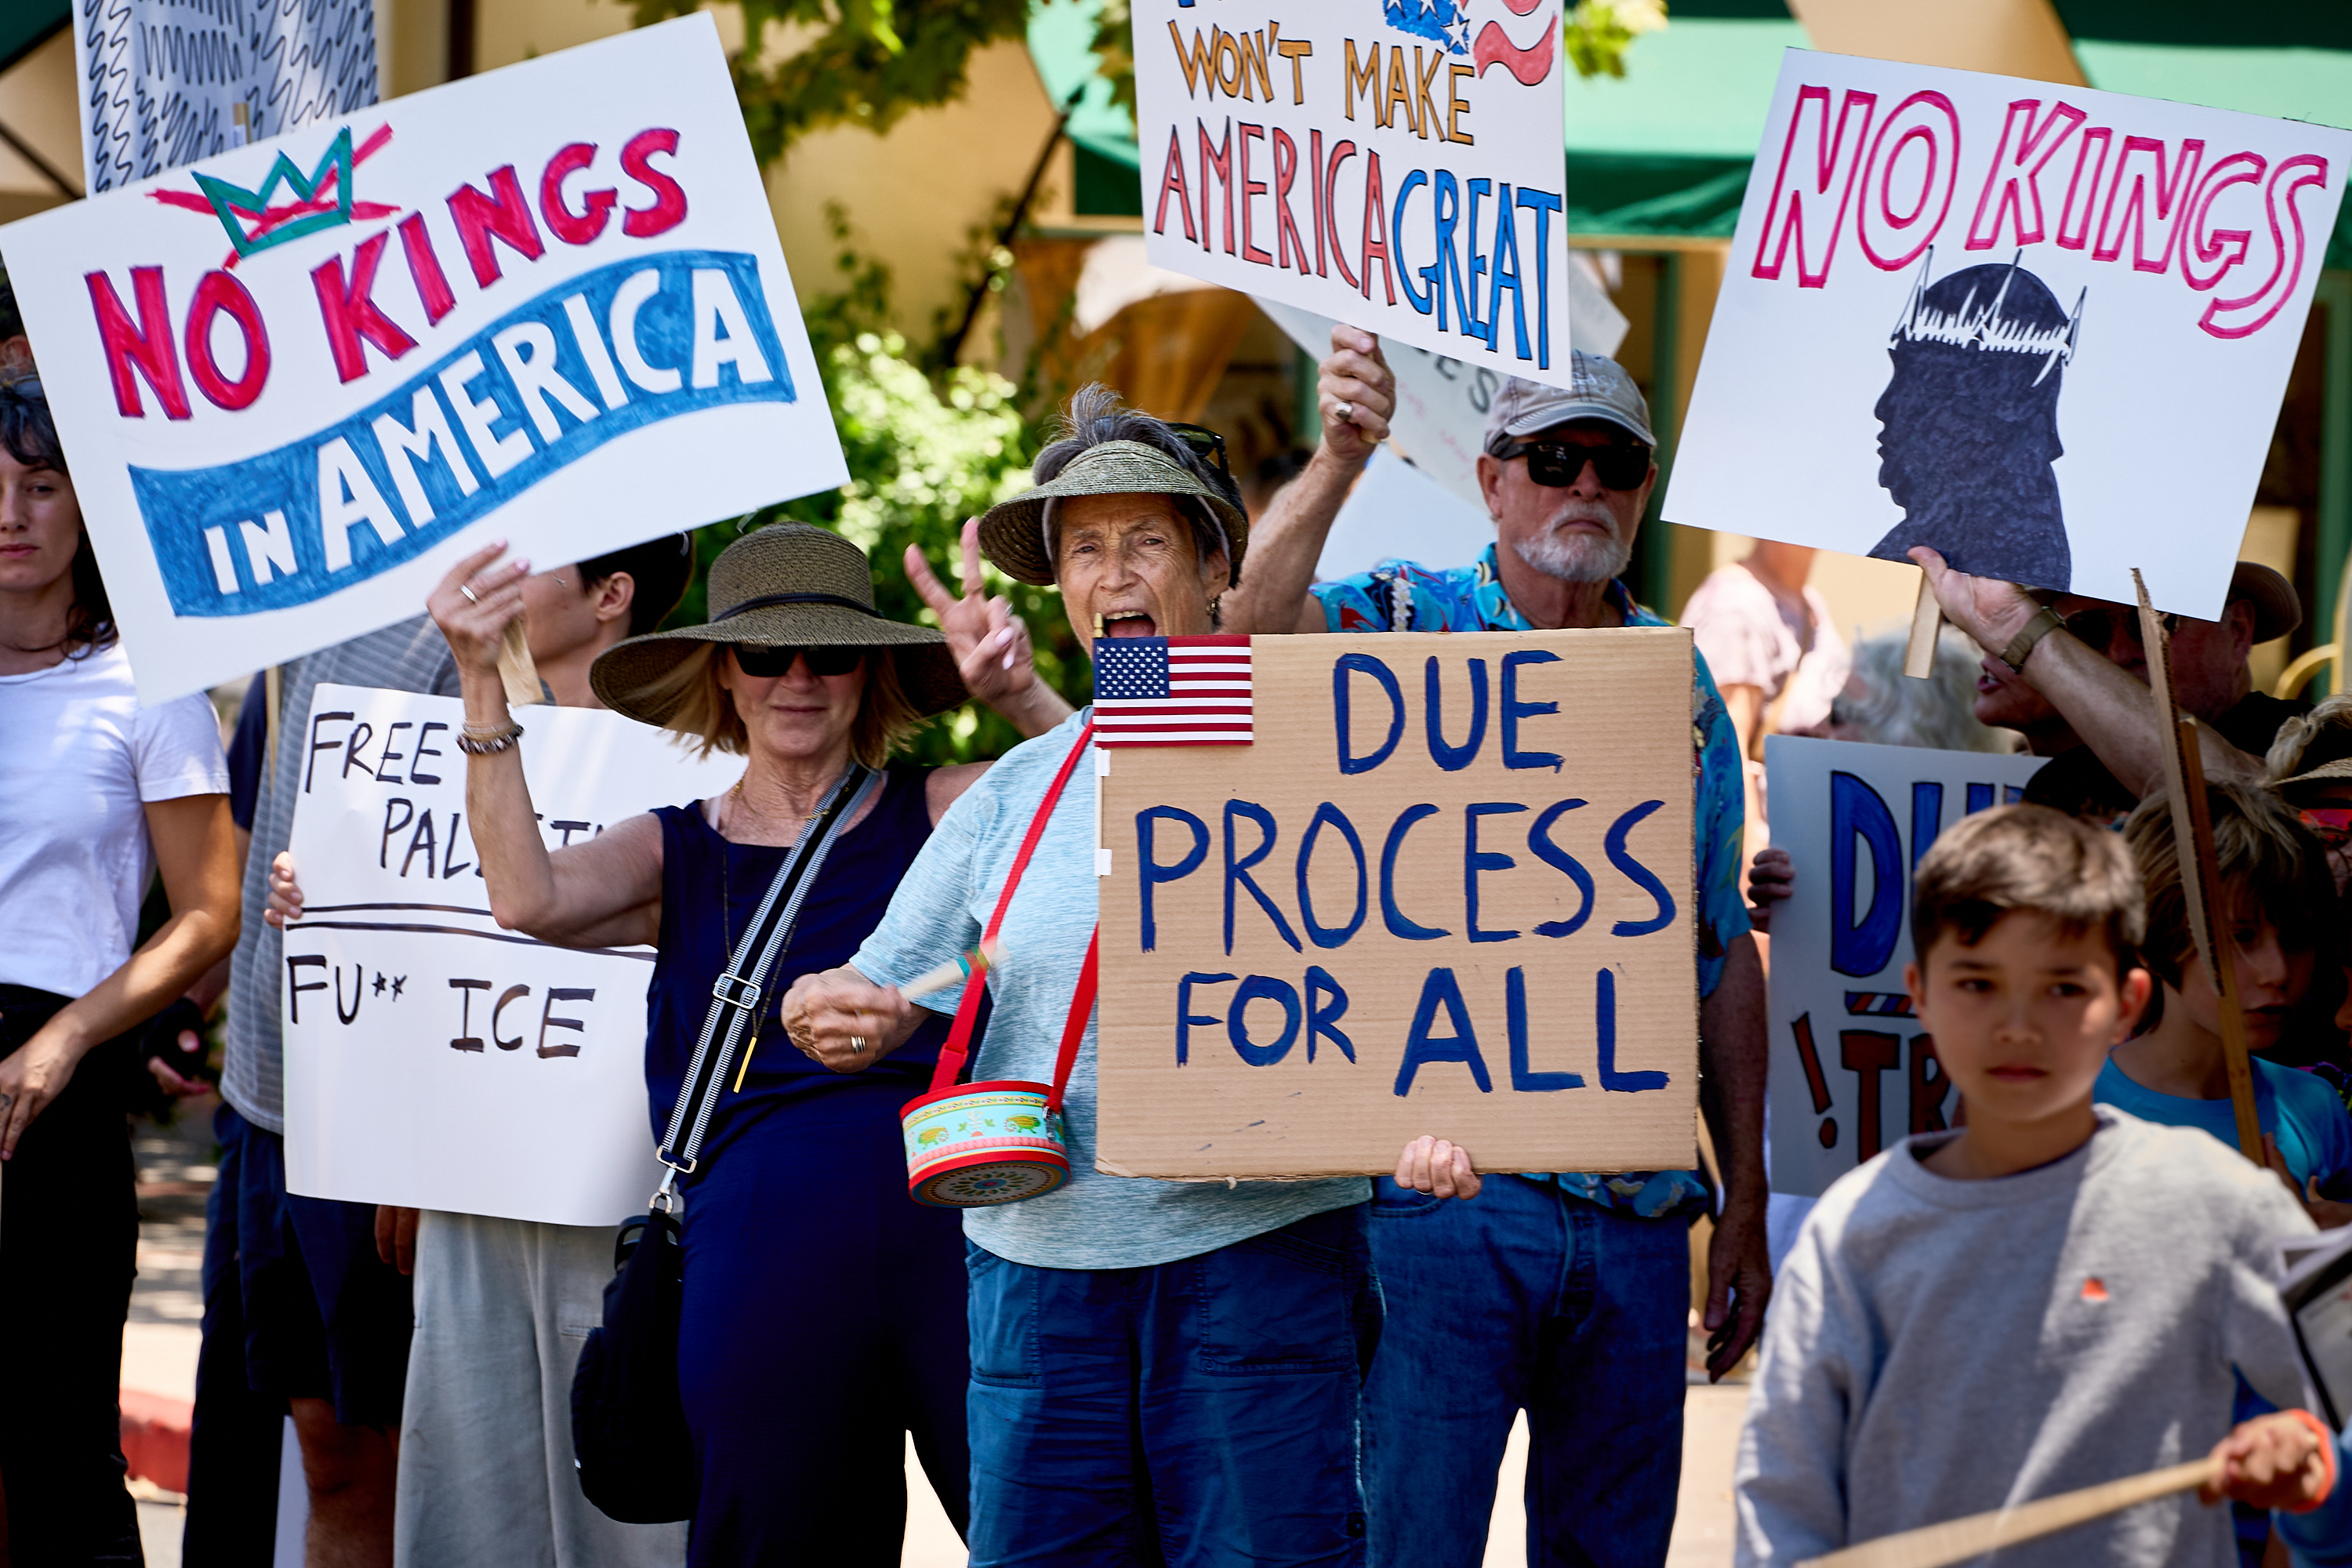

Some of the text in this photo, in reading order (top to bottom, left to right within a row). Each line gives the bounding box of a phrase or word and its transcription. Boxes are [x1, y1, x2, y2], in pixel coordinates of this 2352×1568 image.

[1167, 19, 1475, 146] WON'T MAKE
[84, 128, 688, 420] NO KINGS
[1153, 115, 1563, 369] AMERICA GREAT
[1751, 84, 2328, 339] NO KINGS
[204, 268, 772, 595] IN AMERICA
[305, 711, 449, 793] FREE
[1333, 649, 1566, 775] DUE
[1135, 797, 1678, 956] PROCESS
[448, 978, 596, 1058] ICE
[1176, 965, 1671, 1097] FOR ALL
